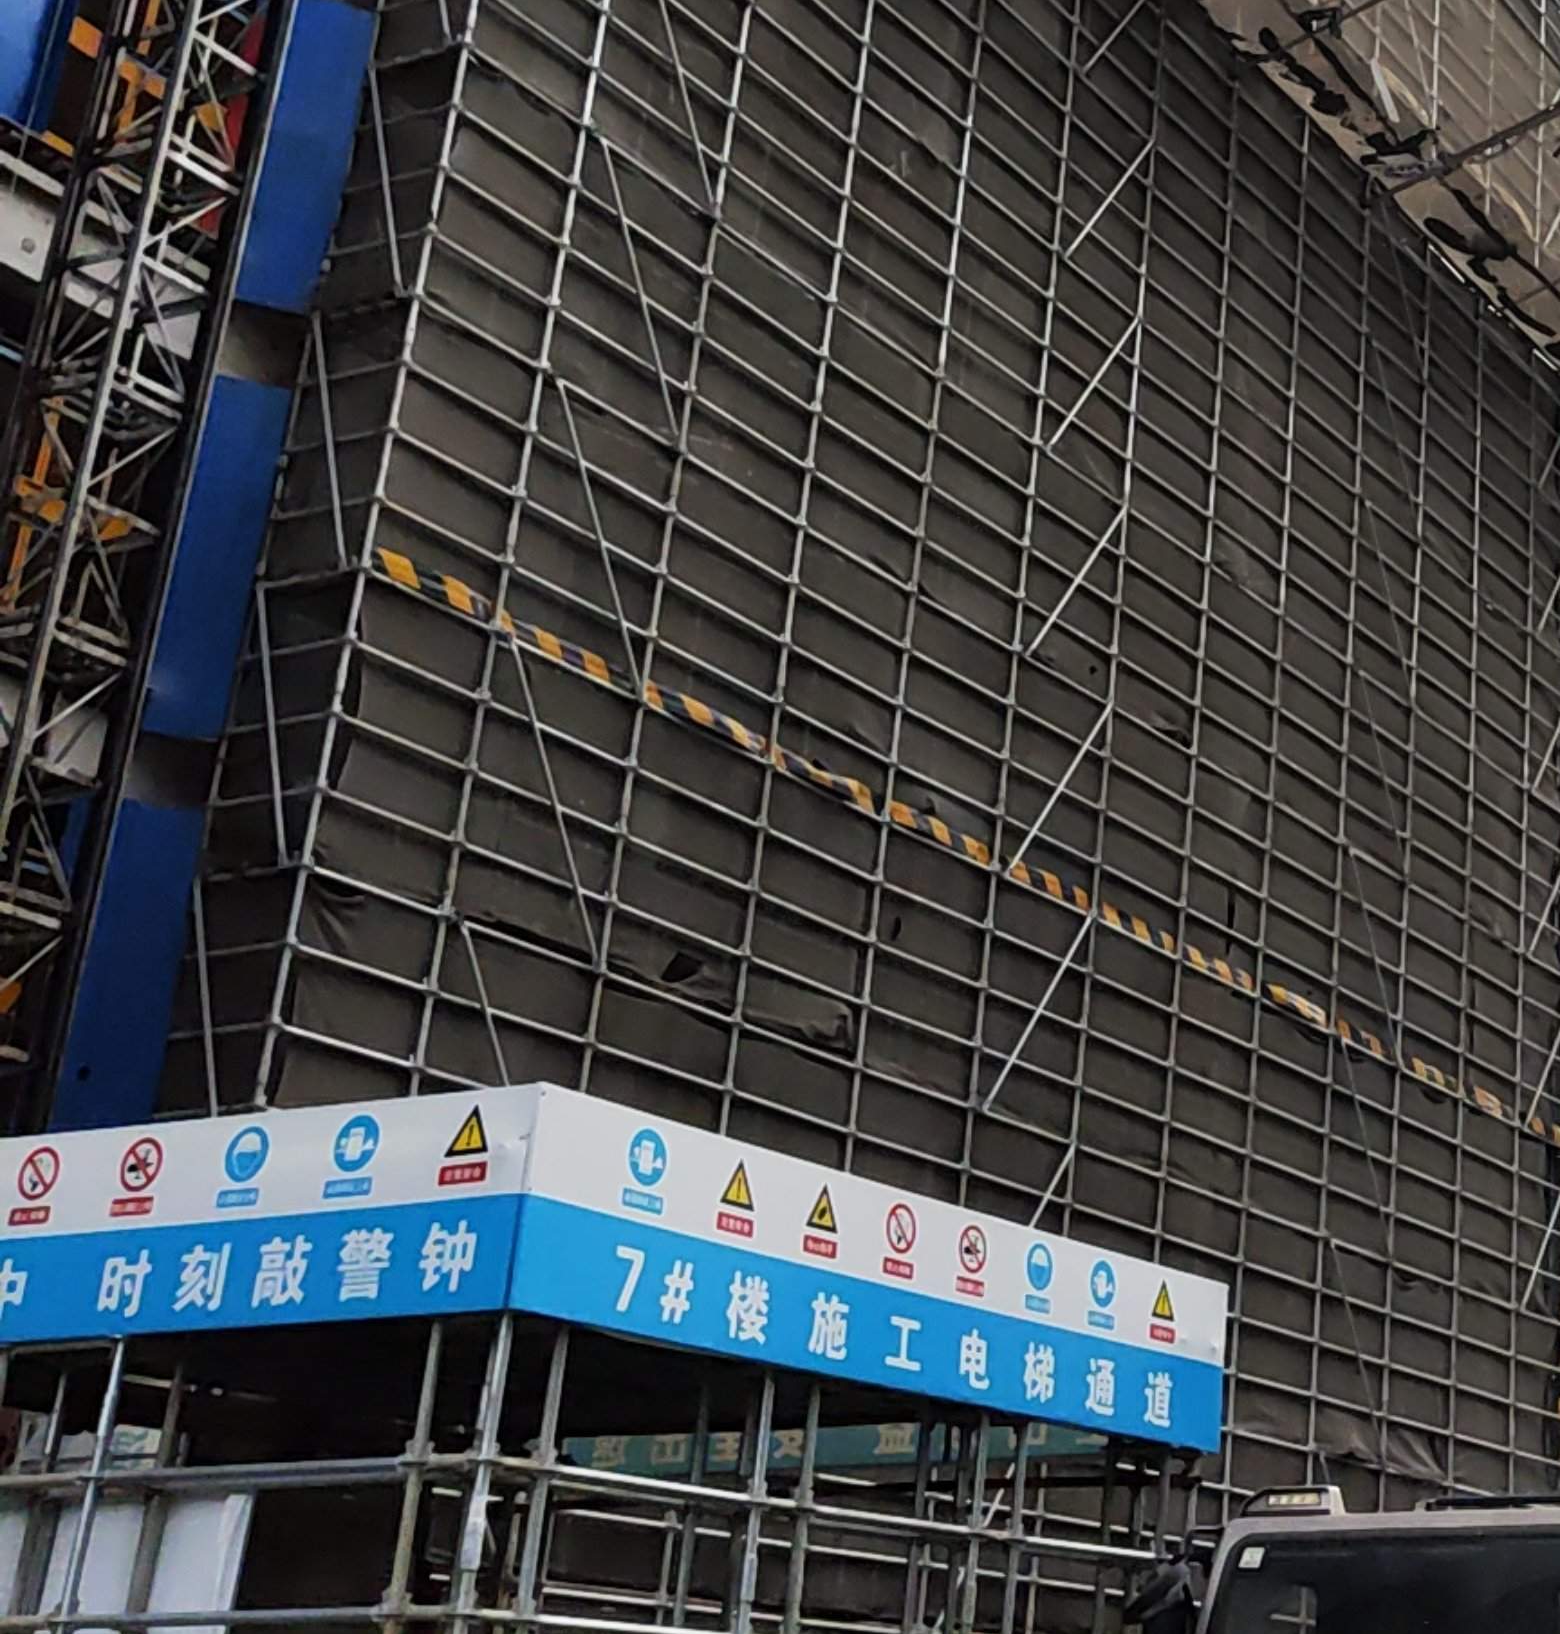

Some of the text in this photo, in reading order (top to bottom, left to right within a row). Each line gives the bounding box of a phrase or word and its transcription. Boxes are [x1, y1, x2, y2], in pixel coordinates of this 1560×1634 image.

[97, 1220, 477, 1317] 时刻敲警钟
[614, 1245, 1173, 1428] 7#楼施工电梯通道
